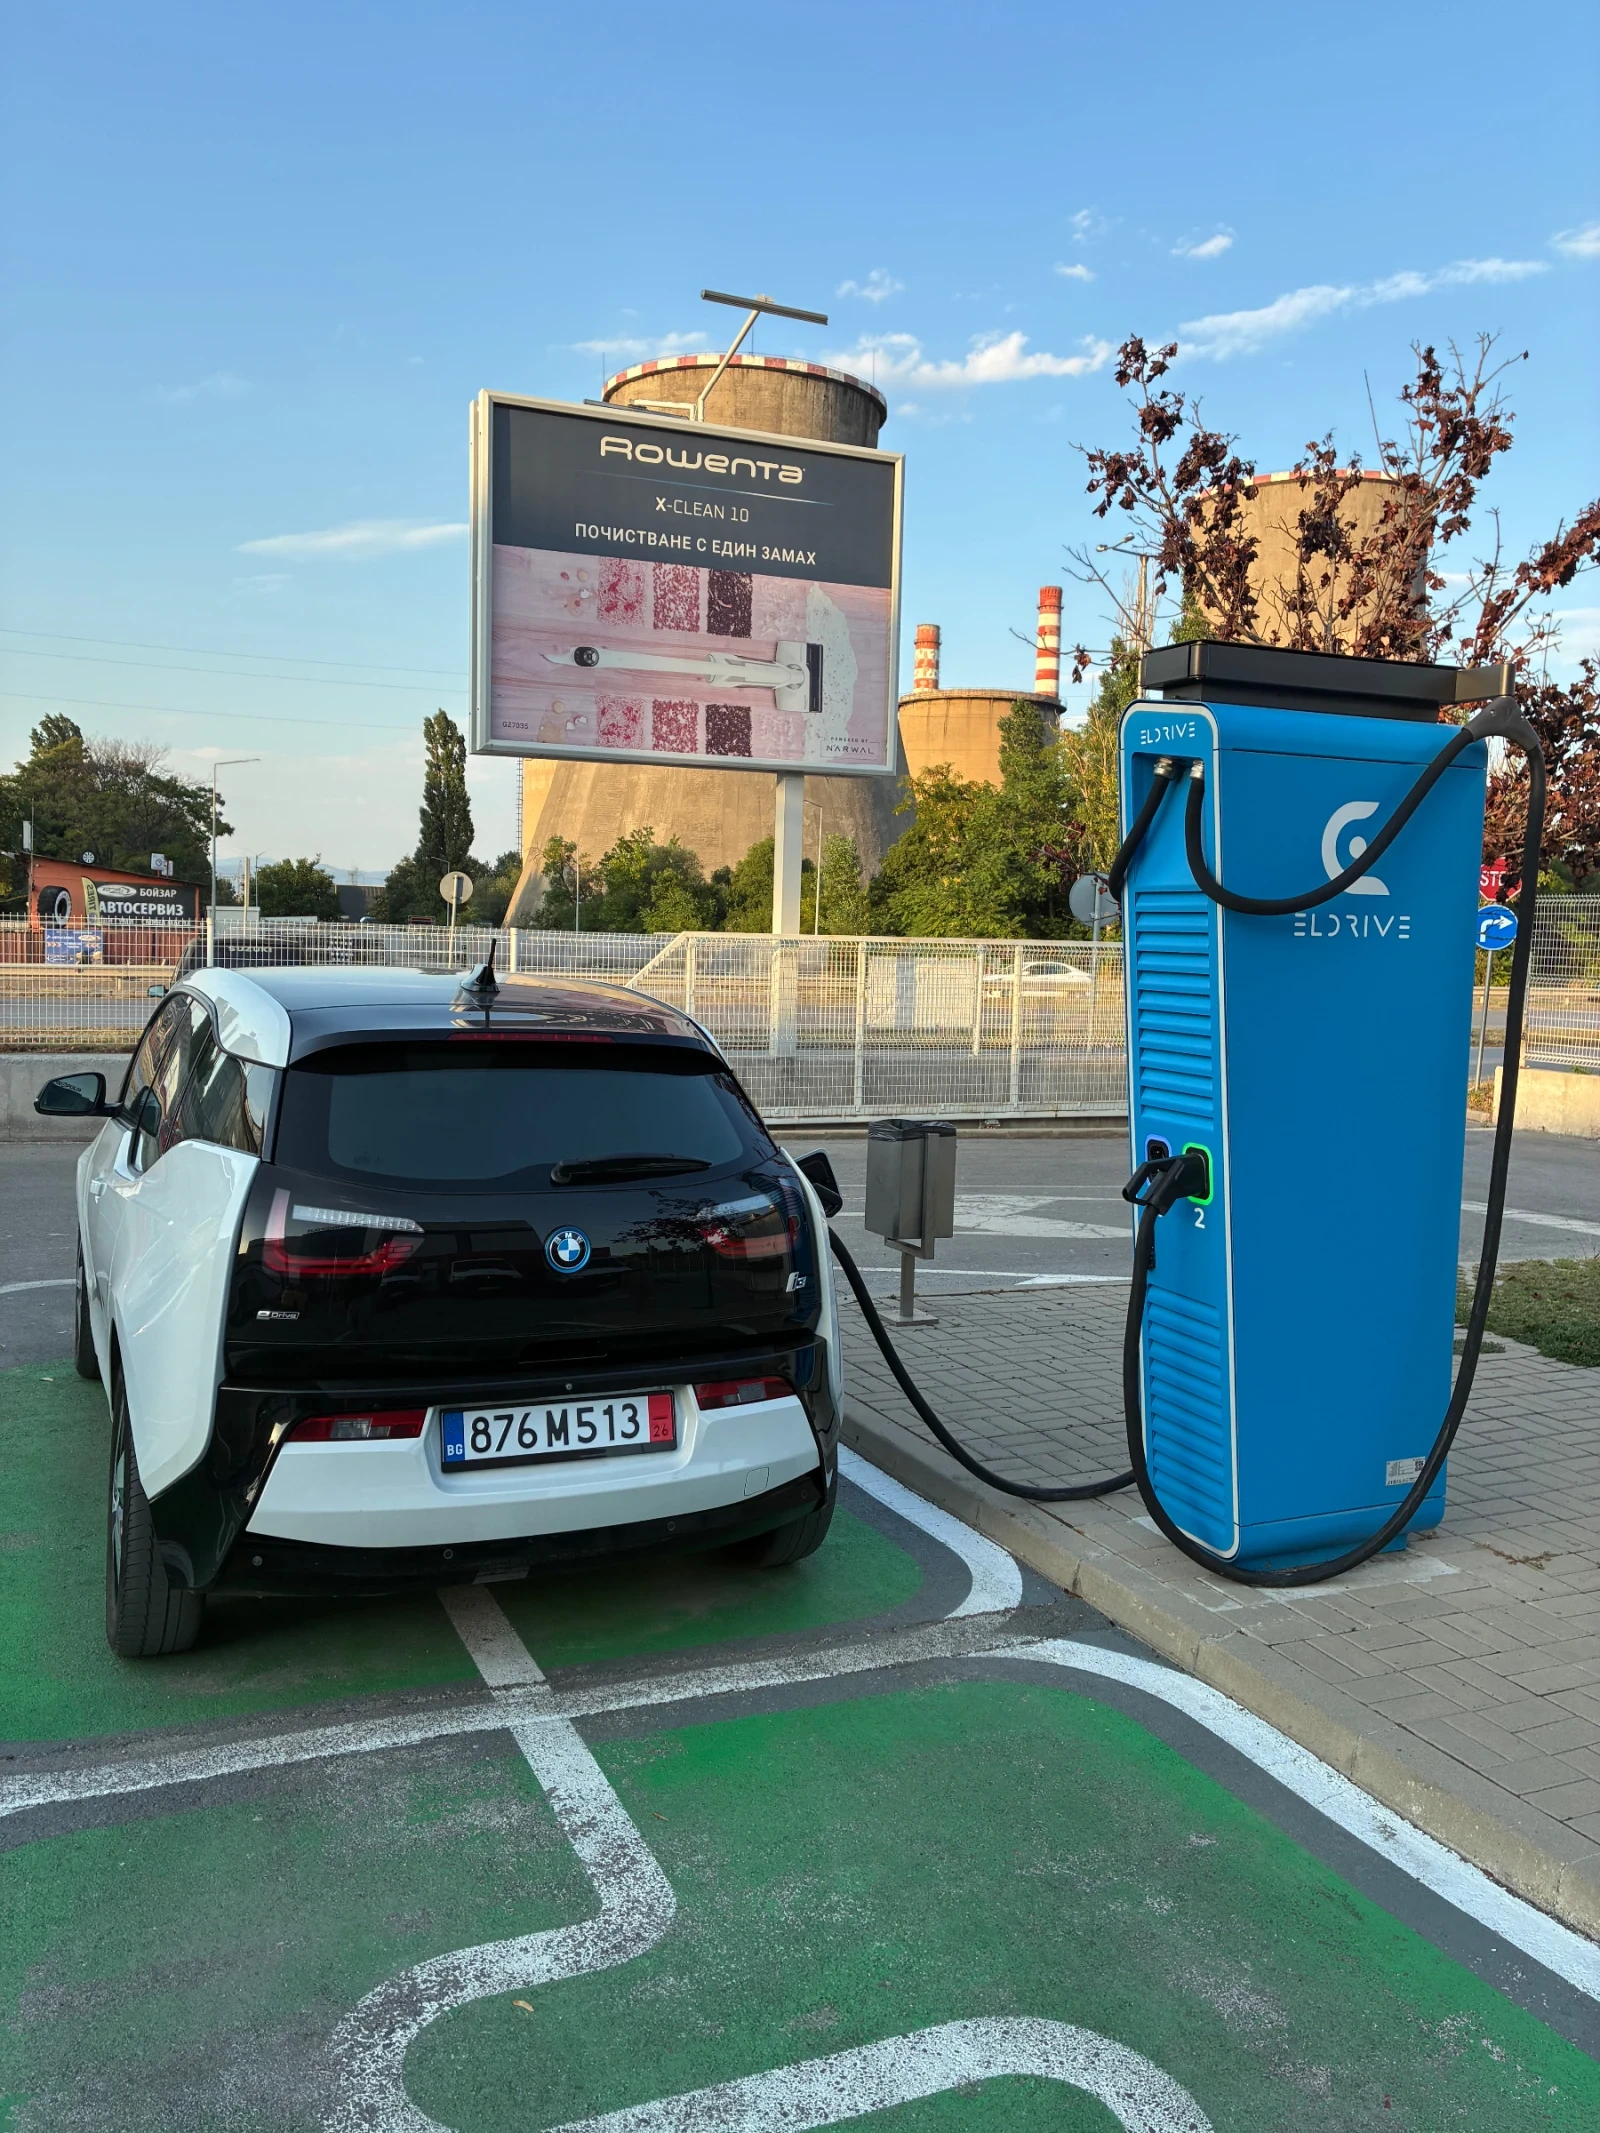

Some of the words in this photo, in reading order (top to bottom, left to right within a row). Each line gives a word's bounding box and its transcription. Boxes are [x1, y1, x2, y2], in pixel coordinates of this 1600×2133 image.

[655, 496, 725, 519] X-CLEAN
[731, 507, 749, 522] 10
[574, 523, 692, 550] ПОЧИСТВАНЕ
[696, 538, 707, 551] С
[712, 540, 757, 557] ЕДИН
[761, 546, 816, 565] ЗАМАХ
[502, 721, 529, 730] GZ7035
[1140, 722, 1195, 744] ELDRIVE
[826, 745, 875, 754] NARWAL
[140, 887, 177, 898] БОЙЗАР
[99, 901, 184, 916] АВТОСЕРВИЗ
[1293, 913, 1411, 939] ELDRIVE
[1194, 1207, 1205, 1229] 2
[553, 1232, 584, 1244] BMW
[786, 1271, 807, 1293] i3
[653, 1424, 669, 1438] 26
[447, 1443, 463, 1456] BG
